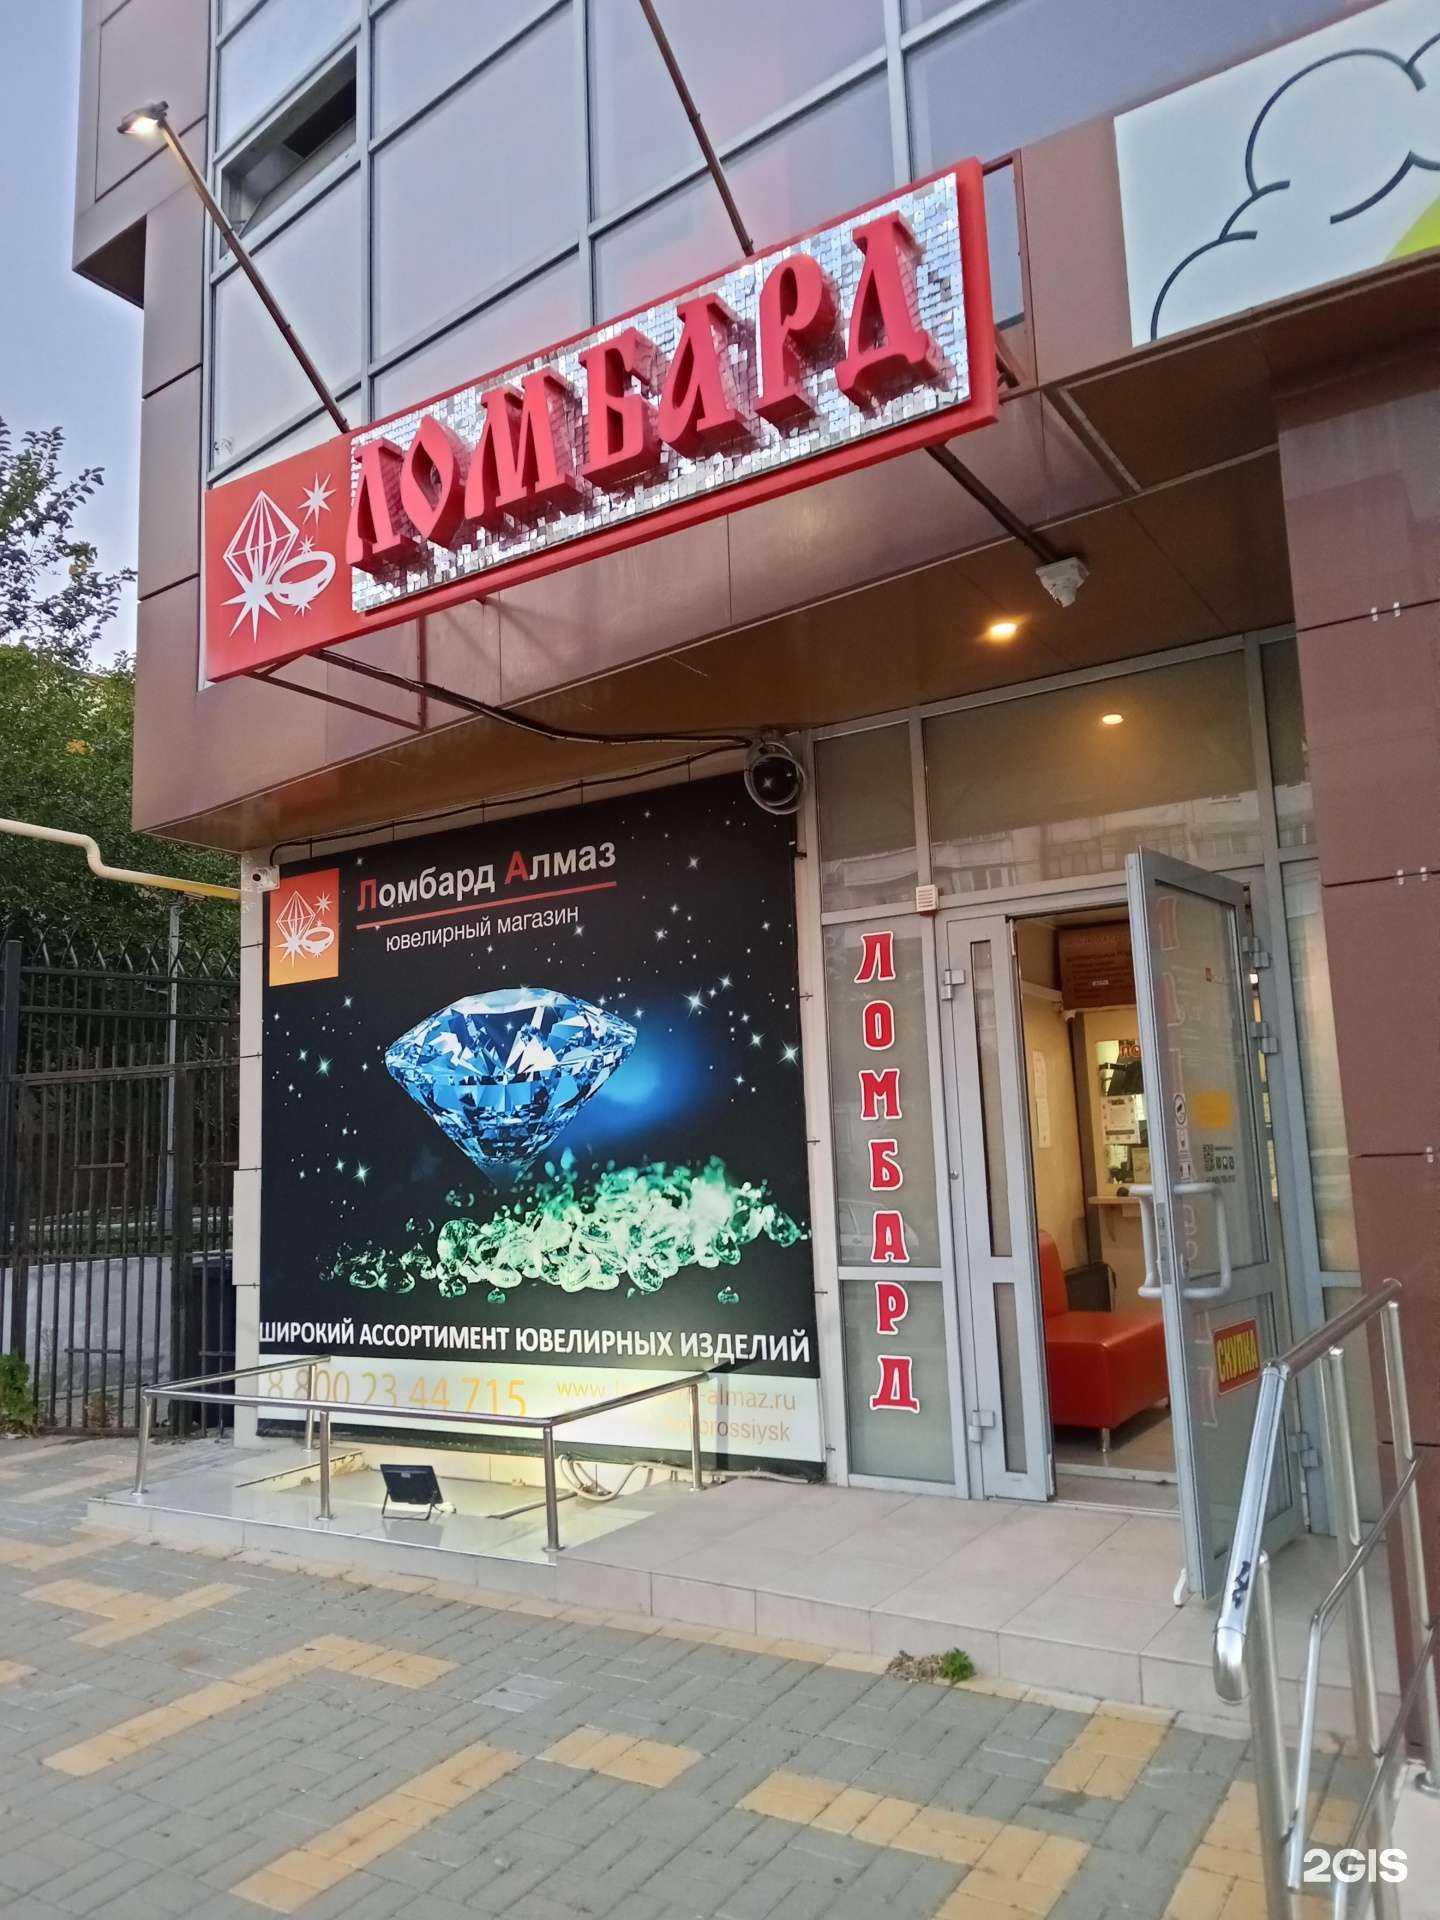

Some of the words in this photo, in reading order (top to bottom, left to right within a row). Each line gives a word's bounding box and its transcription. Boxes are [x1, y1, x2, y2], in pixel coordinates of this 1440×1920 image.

[345, 211, 937, 570] ЛОМБАРД
[357, 864, 496, 912] Ломбард
[504, 842, 616, 885] Алмаз
[386, 917, 491, 952] ювелирный
[498, 906, 579, 934] магазин
[854, 931, 919, 1413] ЛОМБАРД
[259, 1317, 354, 1345] ШИРОКИЙ
[360, 1323, 509, 1351] АССОРТИМЕНТ
[516, 1327, 673, 1358] ЮВЕЛИРНЫХ
[681, 1328, 810, 1365] ИЗДЕЛИЙ
[1216, 1329, 1259, 1383] СКУПКА
[409, 1373, 449, 1413] 44
[462, 1376, 527, 1418] 715
